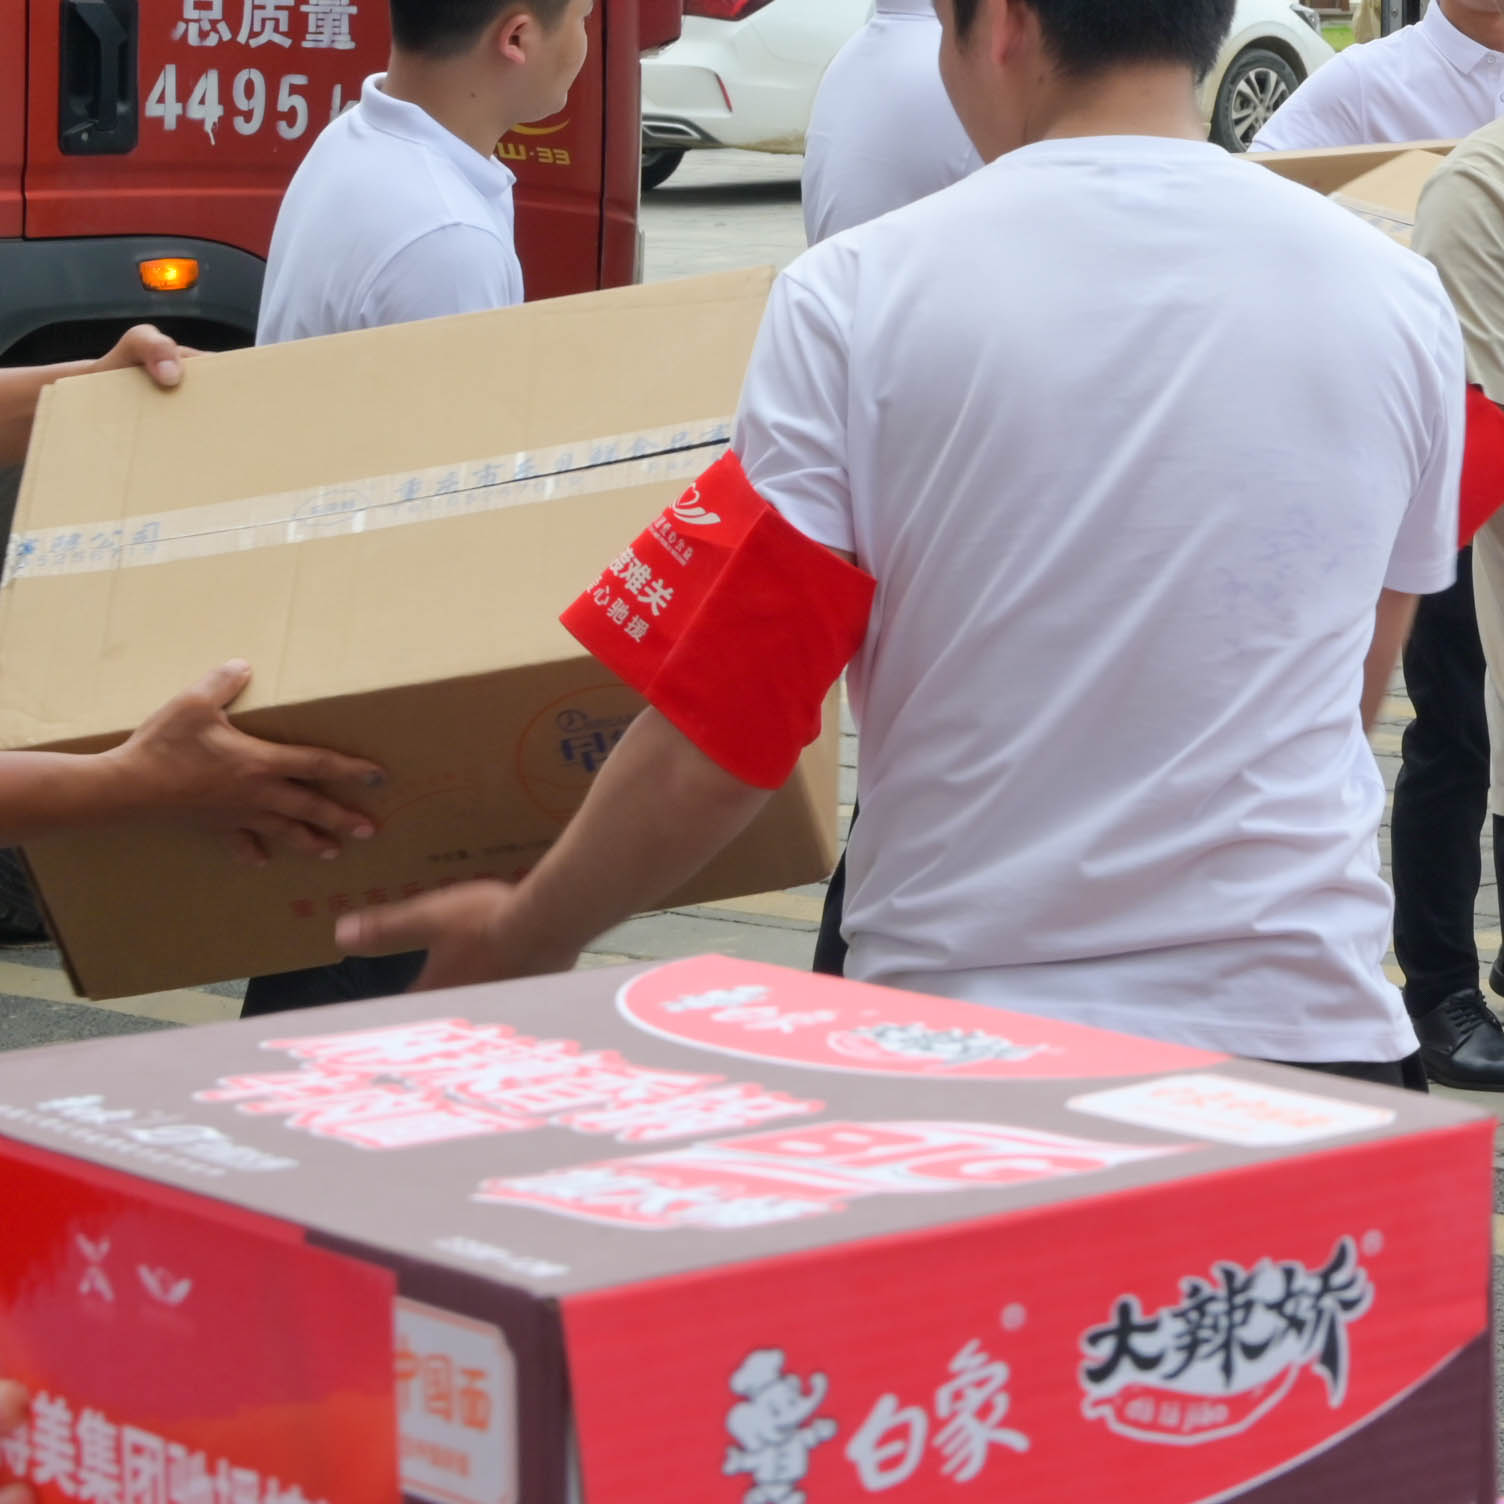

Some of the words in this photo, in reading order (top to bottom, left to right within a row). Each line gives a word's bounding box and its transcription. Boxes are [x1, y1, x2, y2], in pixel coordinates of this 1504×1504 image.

[146, 63, 310, 144] 4495
[1083, 1234, 1372, 1401] 大辣娇
[846, 1339, 1030, 1492] 白象
